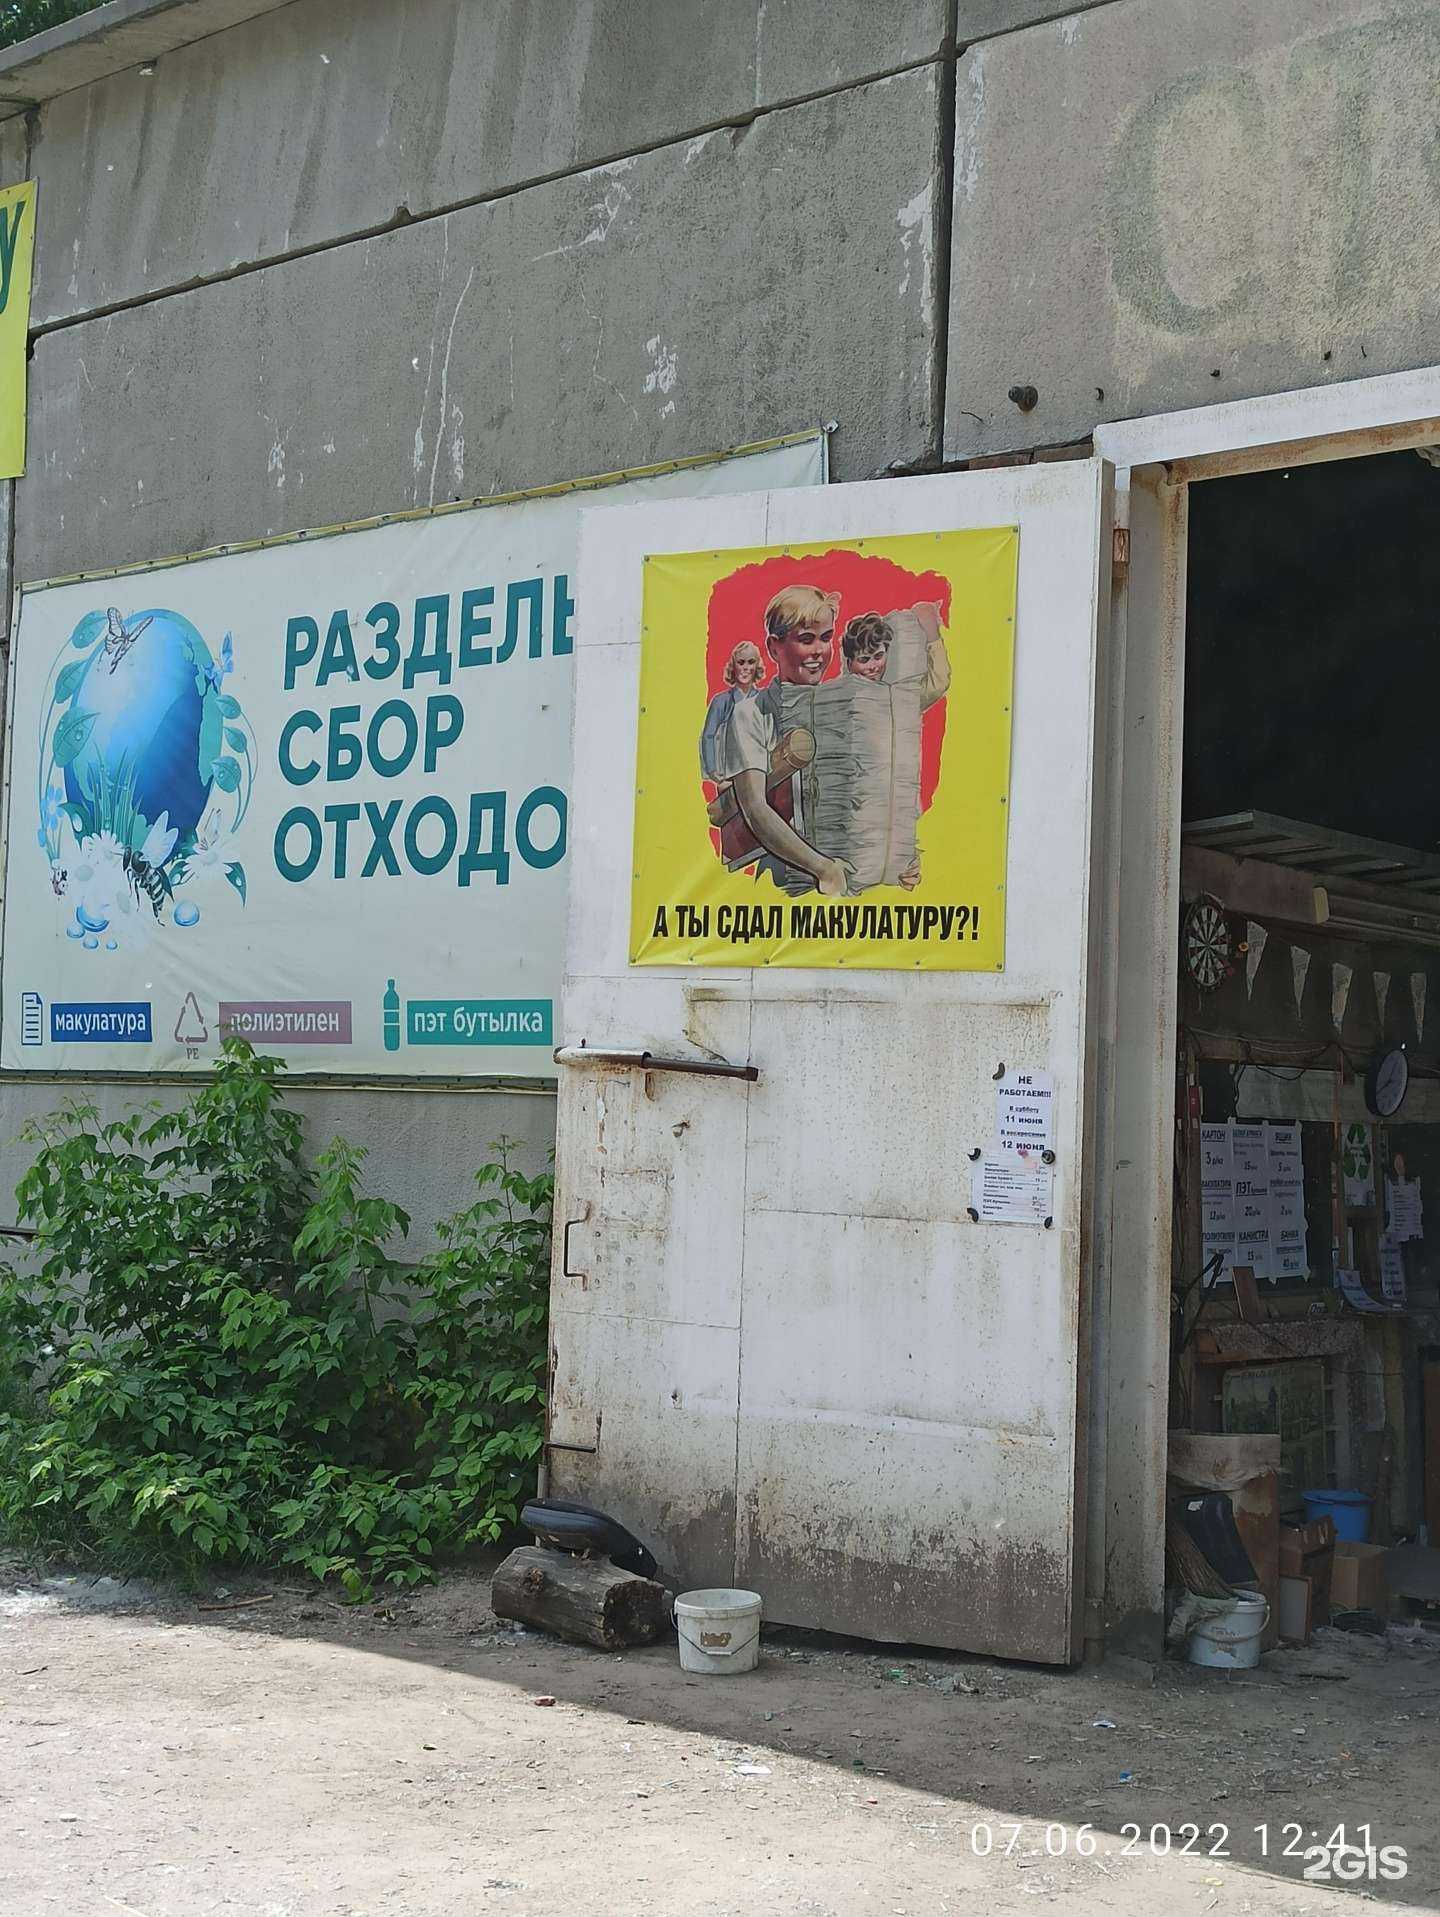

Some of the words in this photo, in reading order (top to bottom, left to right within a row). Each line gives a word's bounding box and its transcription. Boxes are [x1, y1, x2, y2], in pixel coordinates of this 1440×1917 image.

[278, 694, 465, 786] СБОР
[273, 785, 568, 888] ОТХОДО
[652, 905, 669, 938] А
[675, 905, 709, 938] ТЫ
[717, 905, 783, 944] СДАЛ
[790, 904, 979, 941] МАКУЛАТУРУ?!
[55, 1008, 147, 1034] макулатура
[229, 1008, 340, 1034] полиэтилен
[414, 1014, 446, 1034] пэт
[453, 1006, 544, 1033] бутылка
[186, 1047, 200, 1061] PE
[1018, 1075, 1033, 1085] НЕ
[1005, 1115, 1015, 1123] 11
[1018, 1117, 1043, 1125] июня
[1201, 1129, 1226, 1140] КАРТОН
[1001, 1140, 1013, 1149] 12
[1016, 1141, 1045, 1151] июня
[1236, 1181, 1252, 1194] ПЭТ
